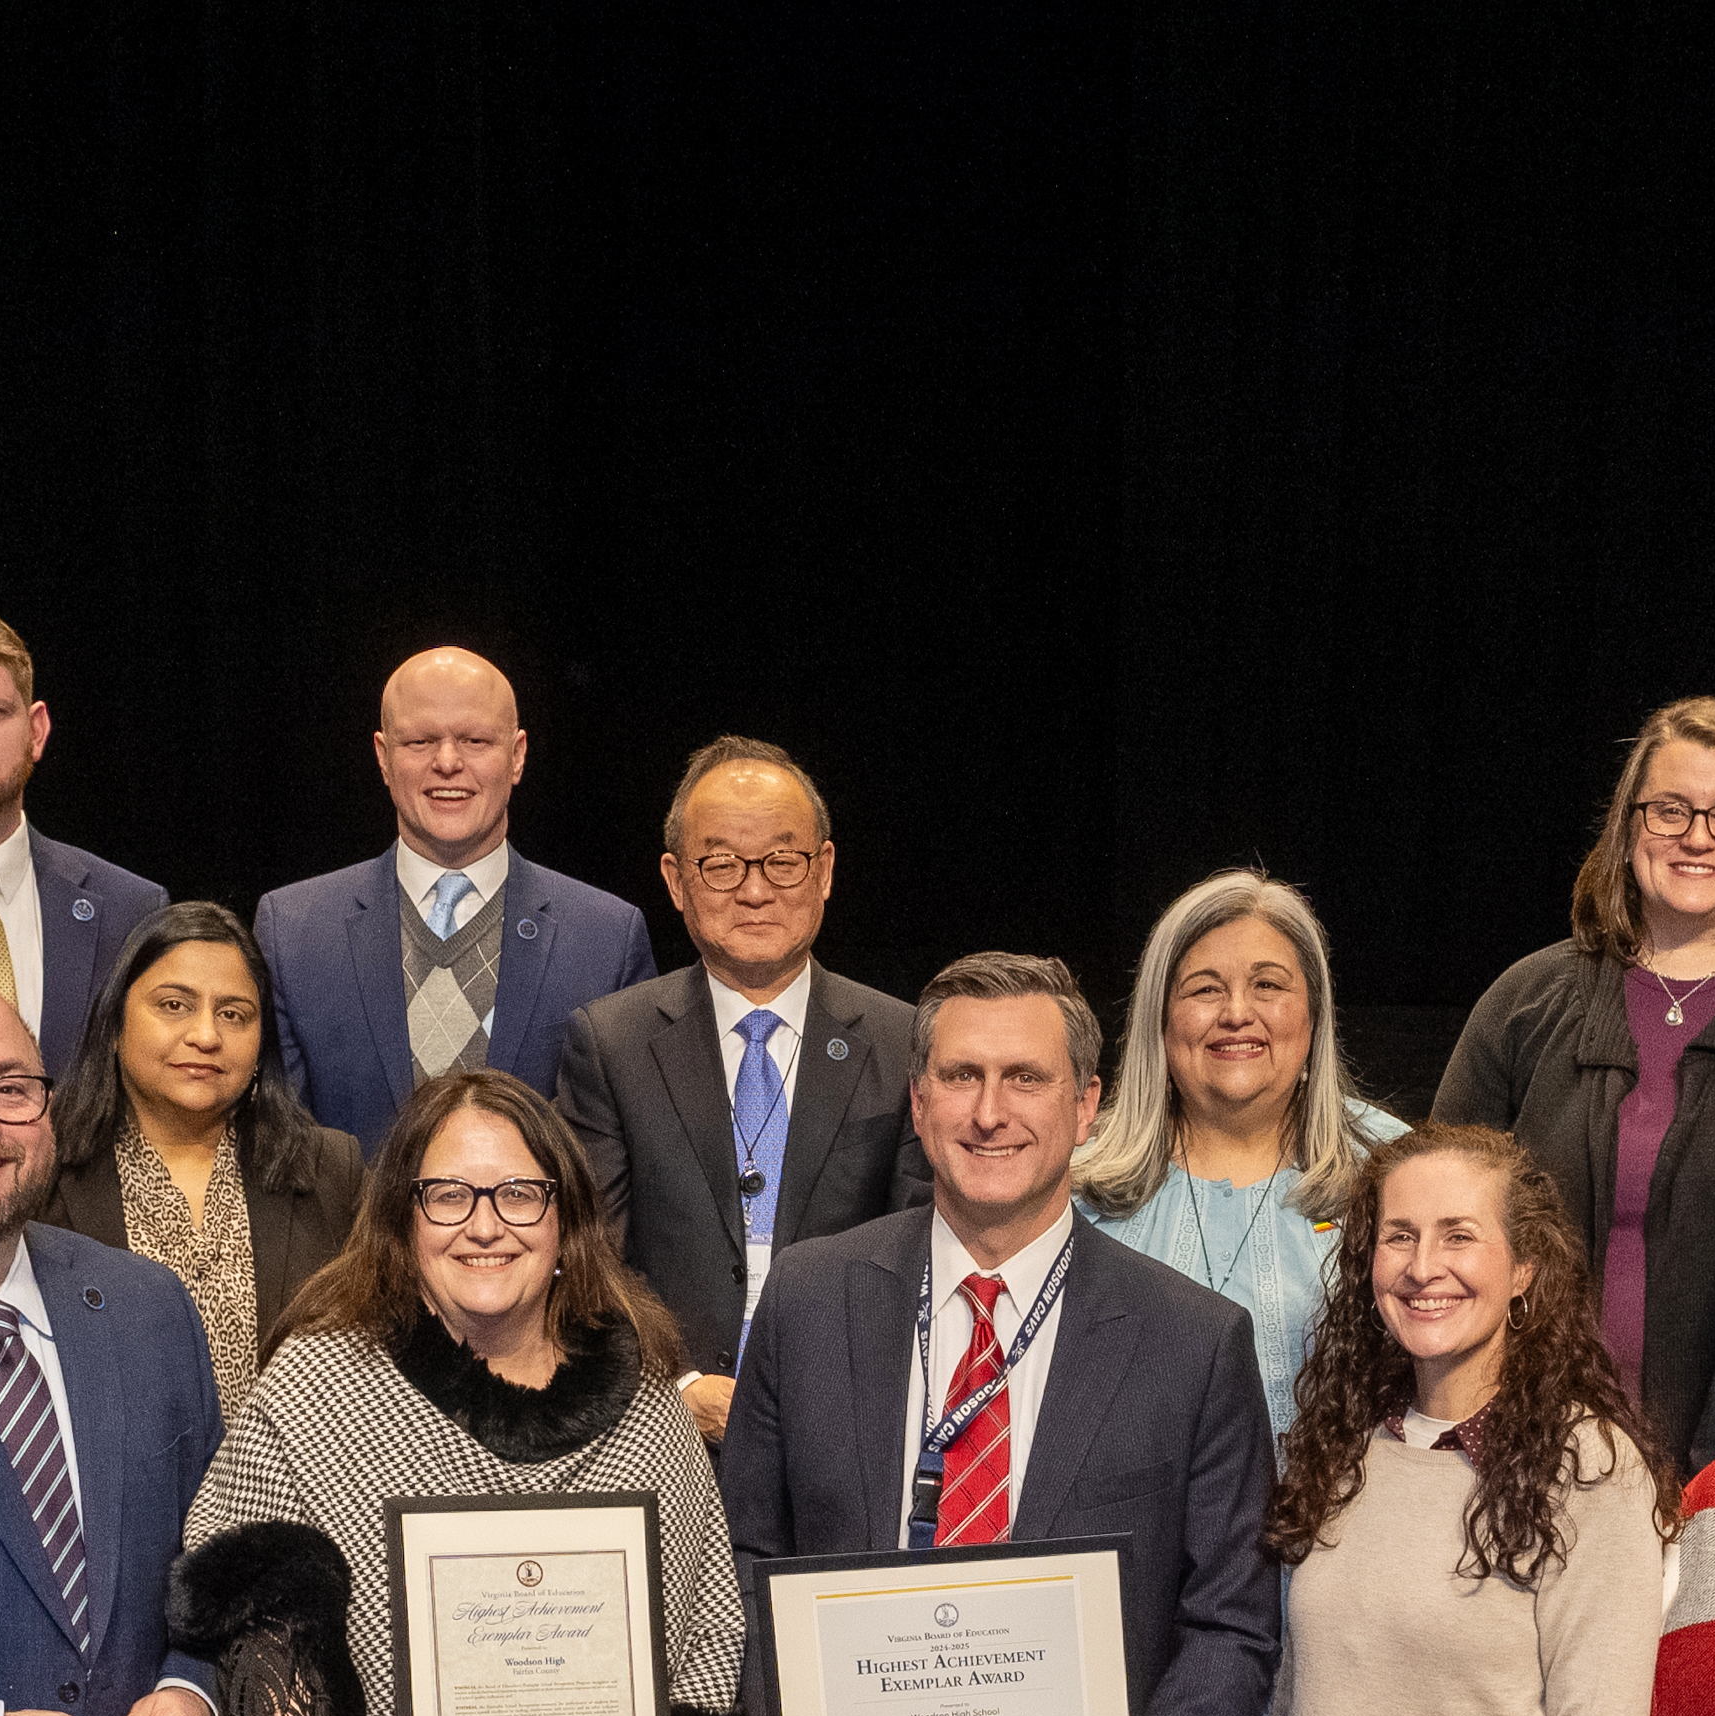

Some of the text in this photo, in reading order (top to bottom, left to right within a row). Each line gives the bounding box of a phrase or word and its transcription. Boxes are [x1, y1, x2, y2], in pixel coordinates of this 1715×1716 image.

[1024, 1299, 1047, 1338] CAVS
[481, 1588, 585, 1600] Virginia Board of Education
[452, 1601, 606, 1625] Highest Achievement
[467, 1624, 595, 1647] Exemplar Award
[929, 1642, 970, 1653] 2024-2025
[505, 1656, 566, 1667] Woodson High
[535, 1667, 561, 1676] County
